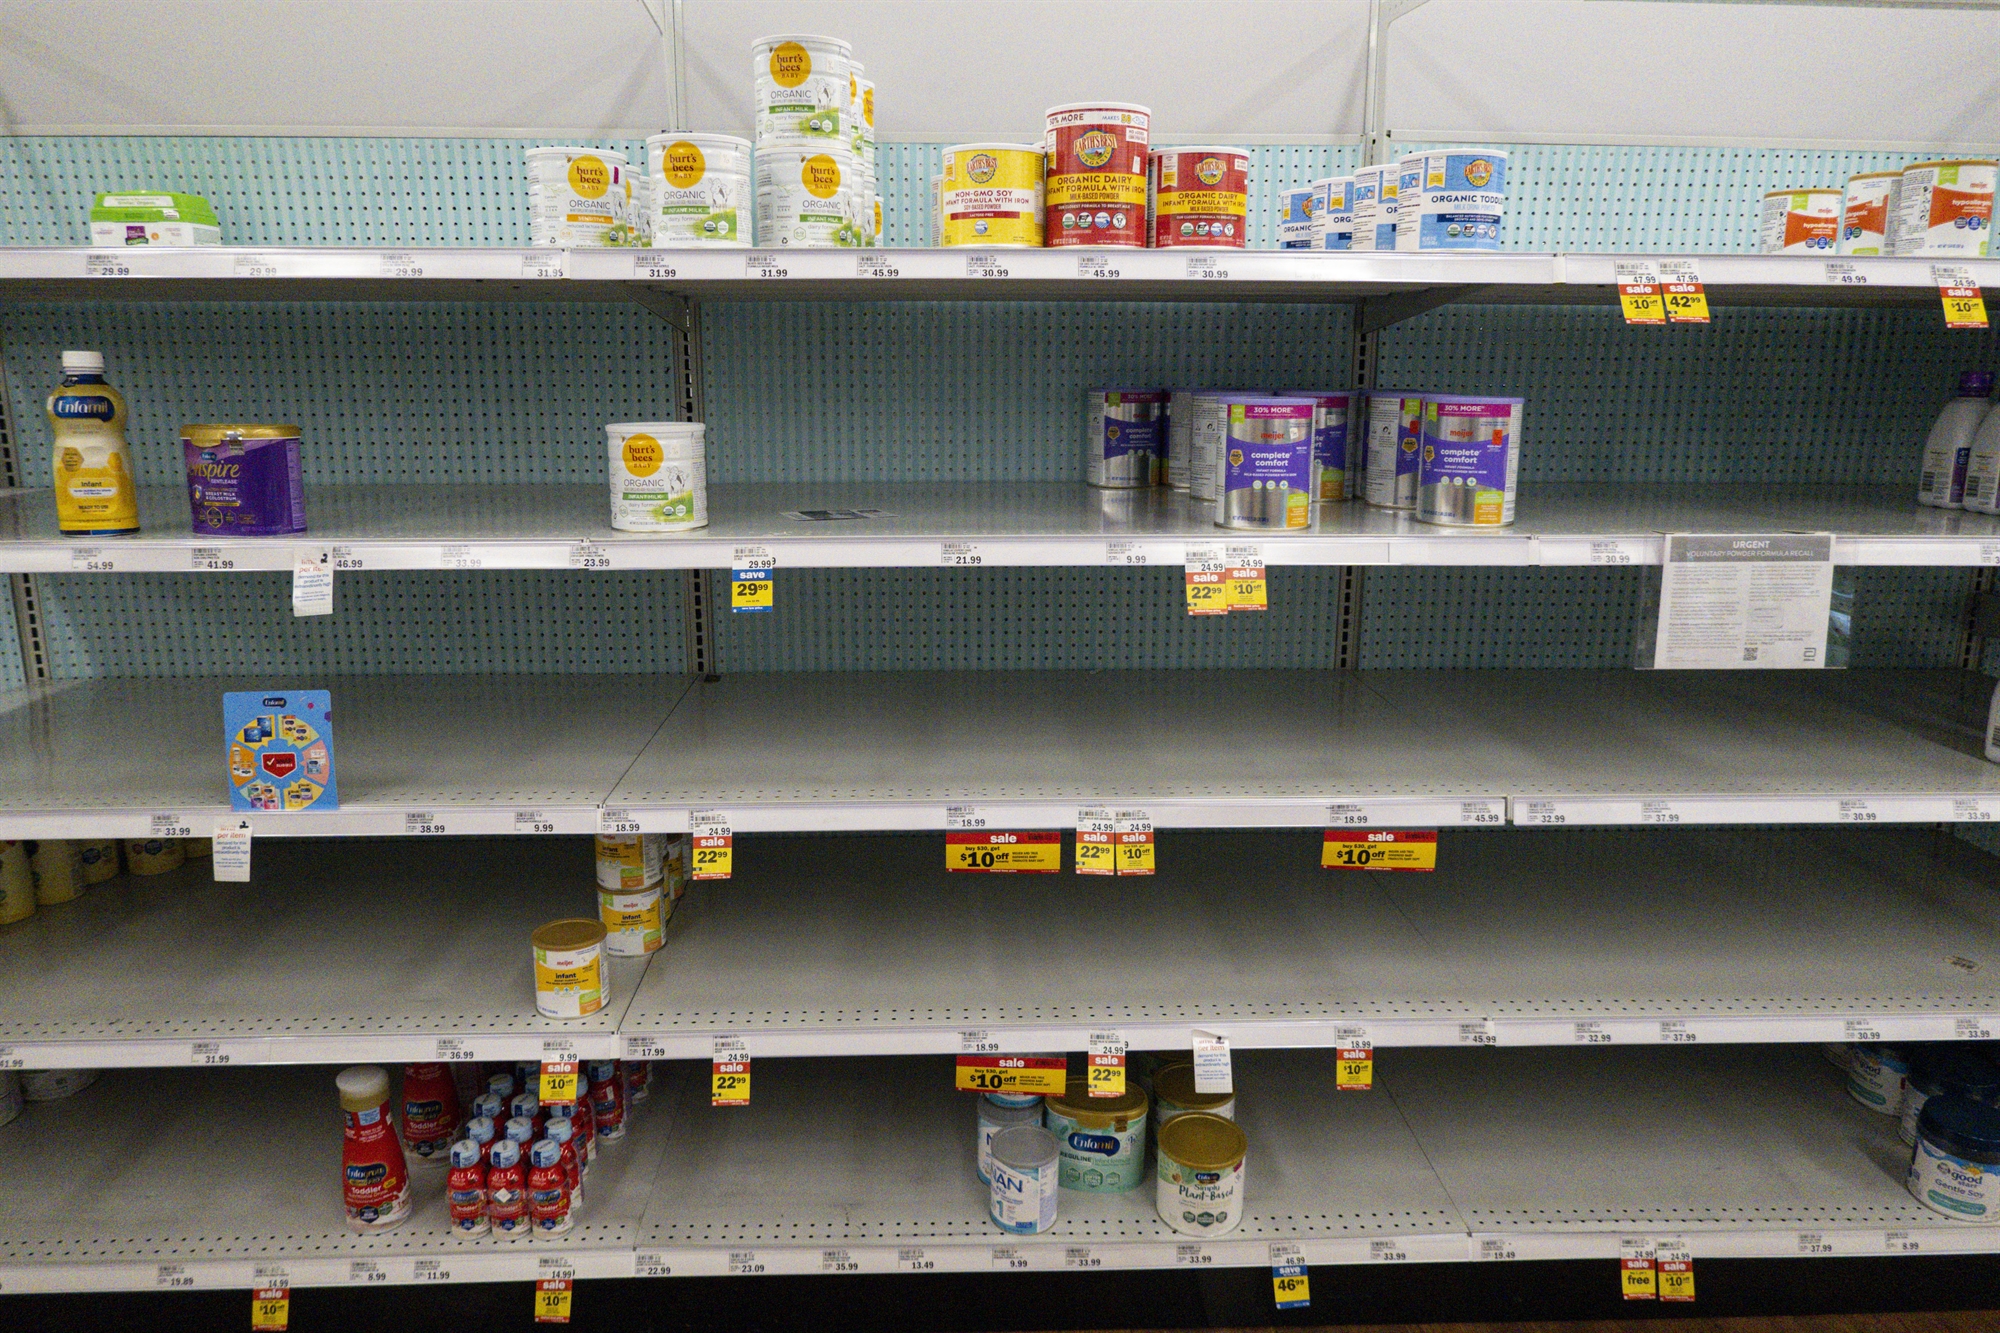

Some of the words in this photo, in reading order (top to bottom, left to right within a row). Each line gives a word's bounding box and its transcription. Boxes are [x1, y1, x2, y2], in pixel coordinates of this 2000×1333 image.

[777, 54, 803, 64] burt's
[780, 63, 800, 71] bees
[771, 90, 812, 99] ORGANIC
[1061, 114, 1084, 122] MORE
[1100, 134, 1117, 148] BEST
[669, 154, 697, 164] burt's
[576, 166, 603, 175] burt's
[672, 163, 694, 173] bees
[810, 165, 835, 175] burt's
[580, 175, 601, 184] bees
[813, 175, 833, 184] bees
[1058, 176, 1100, 185] ORGANIC
[663, 191, 706, 199] ORGANIC
[956, 190, 993, 198] NON-GMO
[569, 199, 611, 209] ORGANIC
[803, 200, 841, 210] ORGANIC
[649, 269, 676, 277] 31.99
[761, 269, 788, 277] 31.99
[872, 269, 899, 277] 45.99
[1626, 285, 1652, 293] sale
[1669, 284, 1695, 292] sale
[1947, 288, 1973, 297] sale
[58, 400, 108, 414] Enfamil
[1261, 431, 1284, 440] meijer
[1450, 429, 1473, 438] meijer
[629, 445, 655, 454] burt's
[632, 454, 653, 462] bees
[624, 479, 664, 487] ORGANIC
[1733, 541, 1770, 549] URGENT
[584, 559, 610, 567] 23.99
[956, 556, 981, 564] 21.99
[1126, 555, 1146, 564] 9.99
[1605, 555, 1630, 563] 30.99
[207, 561, 233, 569] 41.99
[337, 560, 363, 568] 46.99
[749, 560, 771, 568] 29.99
[740, 570, 765, 579] save
[1193, 573, 1218, 582] sale
[1233, 569, 1257, 577] sale
[1344, 816, 1367, 824] 18.99
[1541, 815, 1565, 823] 32.99
[1656, 814, 1679, 822] 37.99
[1967, 812, 1991, 820] 33.99
[961, 819, 985, 827] 18.99
[420, 825, 445, 833] 38.99
[534, 824, 553, 832] 9.99
[615, 824, 640, 832] 18.99
[708, 827, 731, 836] 24.99
[1092, 824, 1113, 832] 24.99
[1130, 824, 1151, 832] 24.99
[990, 833, 1017, 843] sale
[1084, 833, 1108, 842] sale
[1122, 833, 1146, 842] sale
[1368, 833, 1394, 842] sale
[700, 837, 725, 848] sale
[961, 852, 994, 867] $10
[1588, 1034, 1611, 1042] 32.99
[1673, 1033, 1696, 1042] 37.99
[1858, 1032, 1881, 1040] 30.99
[1968, 1030, 1990, 1038] 33.99
[975, 1043, 999, 1052] 18.99
[1350, 1040, 1371, 1049] 18.99
[641, 1048, 665, 1056] 17.99
[1103, 1046, 1124, 1055] 24.99
[1342, 1049, 1366, 1059] sale
[205, 1055, 229, 1064] 31.99
[450, 1051, 474, 1060] 36.99
[559, 1053, 577, 1062] 9.99
[728, 1053, 749, 1062] 24.99
[999, 1058, 1025, 1067] sale
[1095, 1056, 1118, 1065] sale
[547, 1064, 571, 1073] sale
[719, 1063, 744, 1073] sale
[1073, 1136, 1114, 1149] Enfamil
[1951, 1172, 1982, 1184] good
[351, 1186, 382, 1194] Toddler
[1179, 1185, 1233, 1200] Plant-Based
[1935, 1179, 1965, 1194] Gentle
[1968, 1190, 1984, 1198] Soy
[1189, 1256, 1212, 1264] 33.99
[1384, 1252, 1406, 1261] 33.99
[836, 1263, 858, 1271] 35.99
[1010, 1260, 1028, 1268] 9.99
[1078, 1259, 1101, 1267] 33.99
[648, 1267, 671, 1275] 22.99
[741, 1264, 765, 1273] 23.09
[1628, 1275, 1649, 1285] free
[542, 1280, 565, 1290] sale
